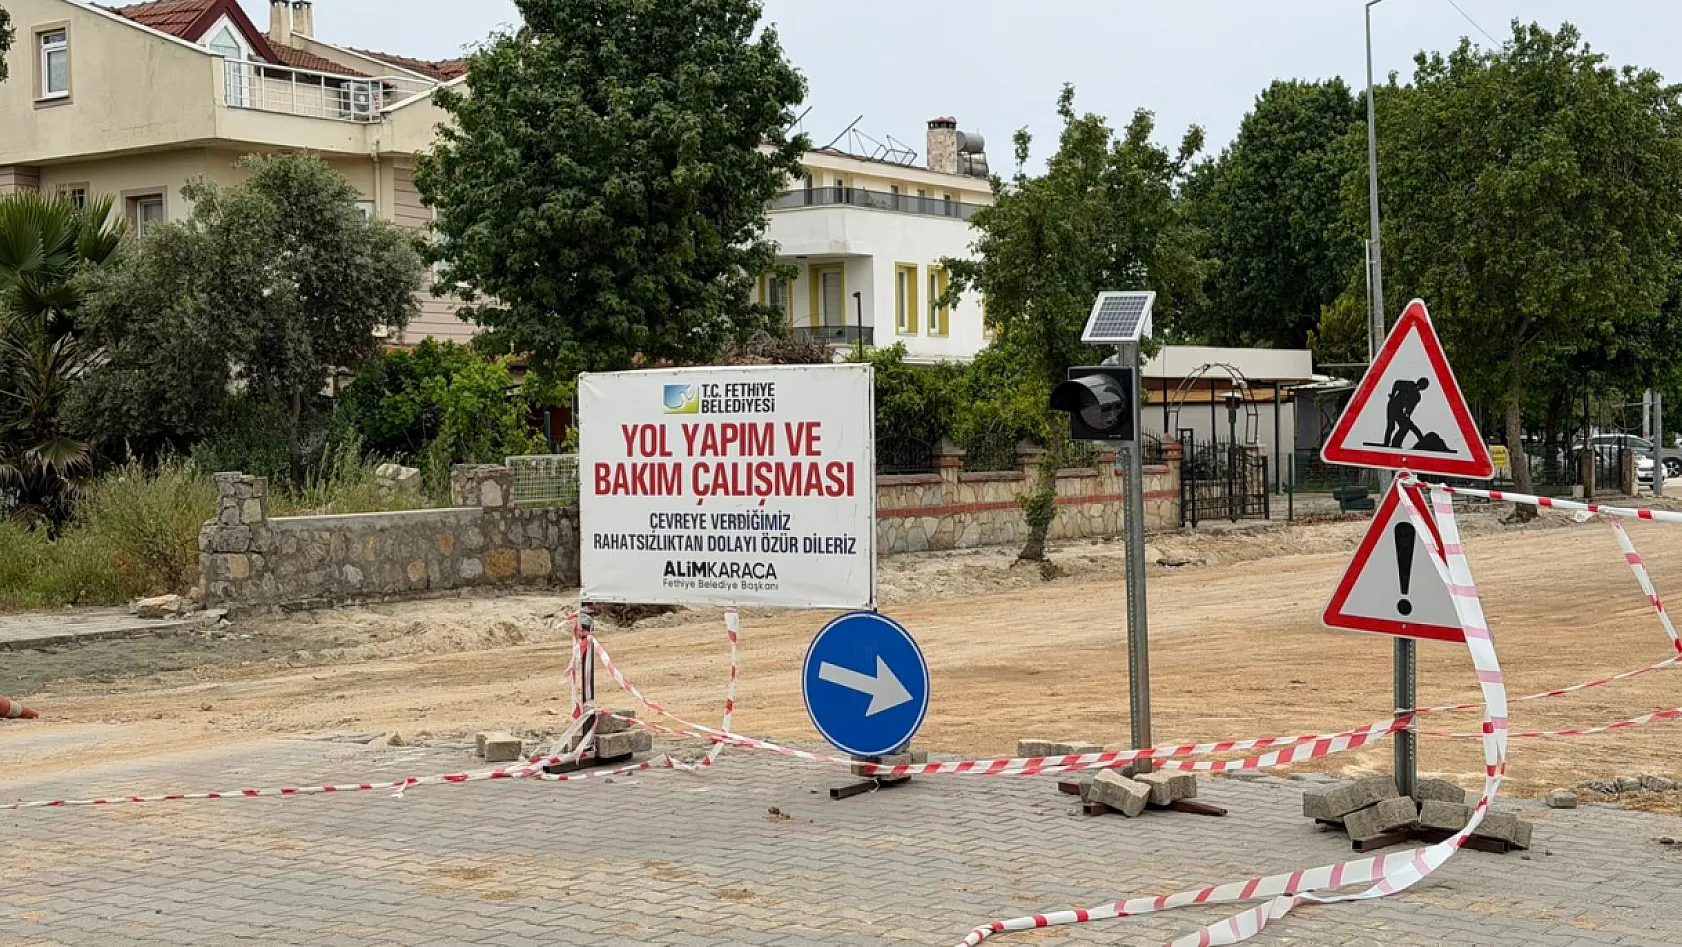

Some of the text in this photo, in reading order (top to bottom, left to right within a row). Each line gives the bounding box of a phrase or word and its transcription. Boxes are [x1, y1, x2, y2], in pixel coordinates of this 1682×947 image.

[701, 383, 722, 398] T.C.
[622, 422, 821, 457] YOL YAPIM VE
[595, 461, 854, 506] BAKIM ÇALIŞMASI
[650, 509, 791, 533] ÇEVREYE VERDİĞİMİZ
[593, 532, 857, 555] RAHATSIZLIKTAN DOLAYI ÖZÜR DİLERİZ
[663, 579, 779, 592] Fethiye Belediye Başkanı
